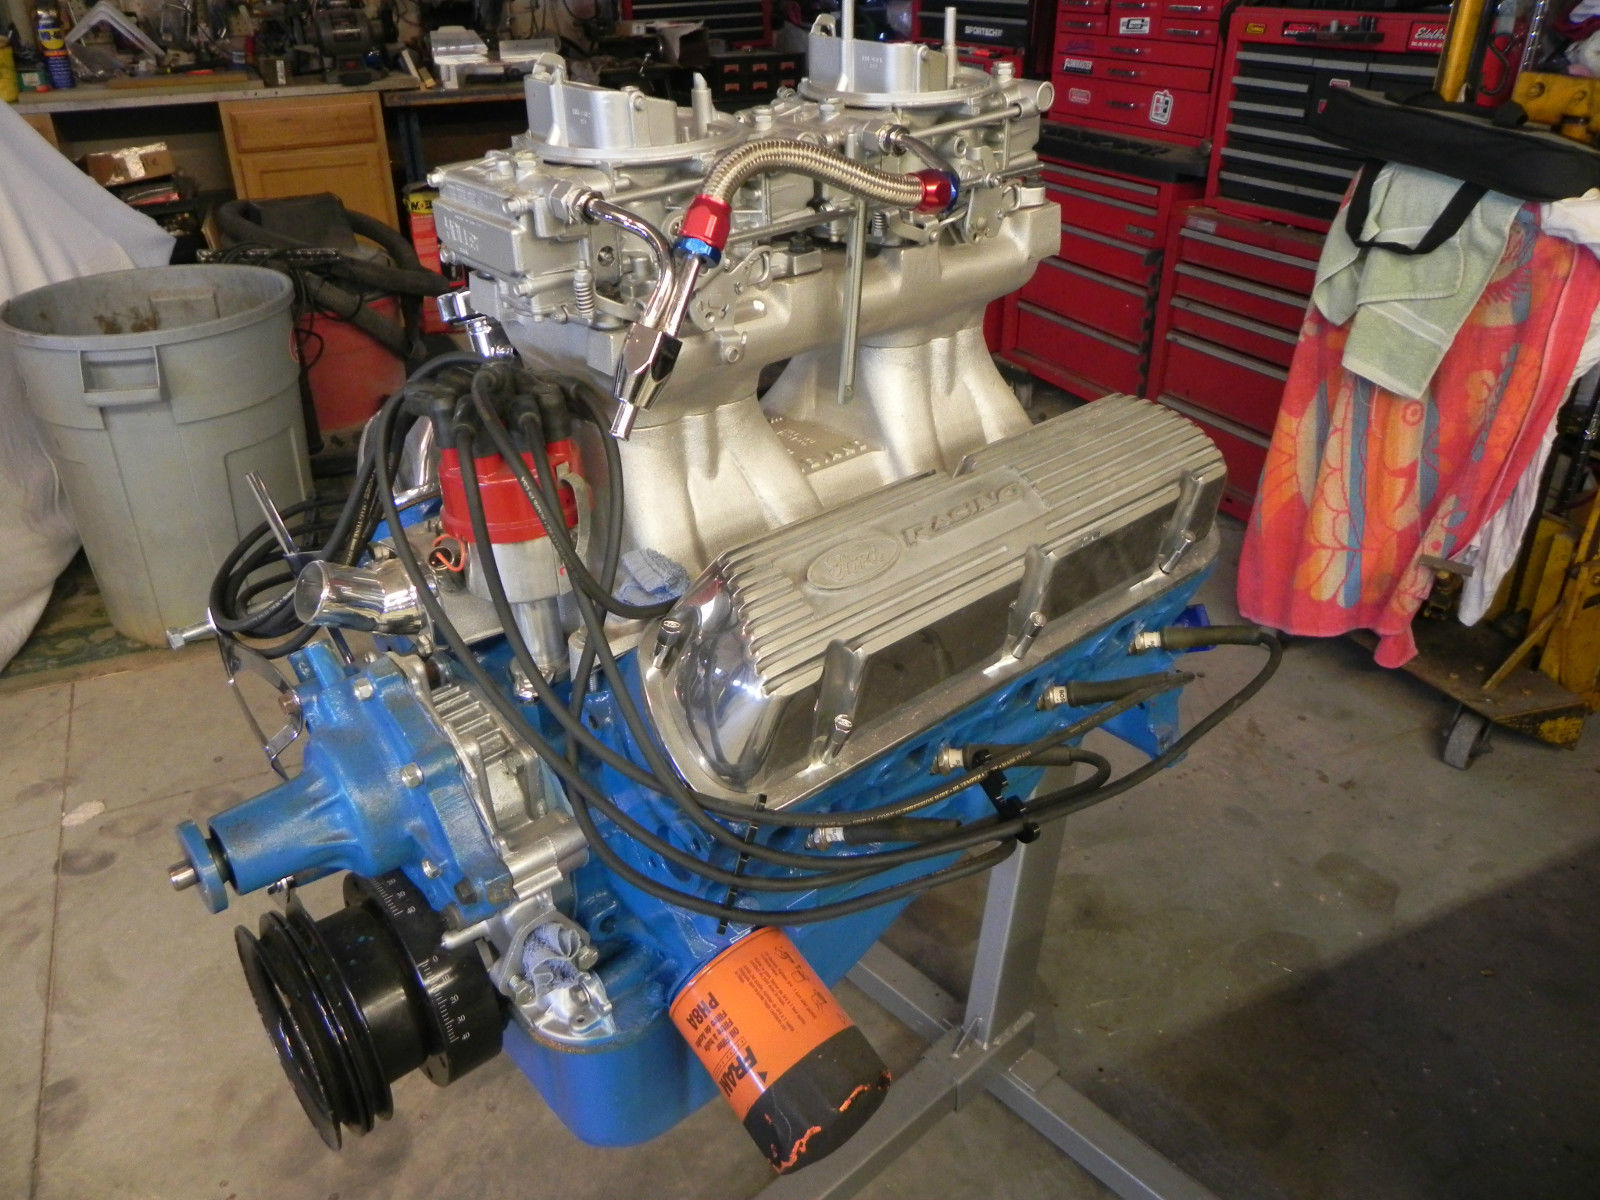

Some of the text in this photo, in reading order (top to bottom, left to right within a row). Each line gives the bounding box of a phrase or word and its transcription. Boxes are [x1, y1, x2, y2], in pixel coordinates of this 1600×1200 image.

[902, 482, 1024, 547] RACING
[685, 992, 719, 1031] PH8A
[717, 1046, 758, 1098] FRAM
